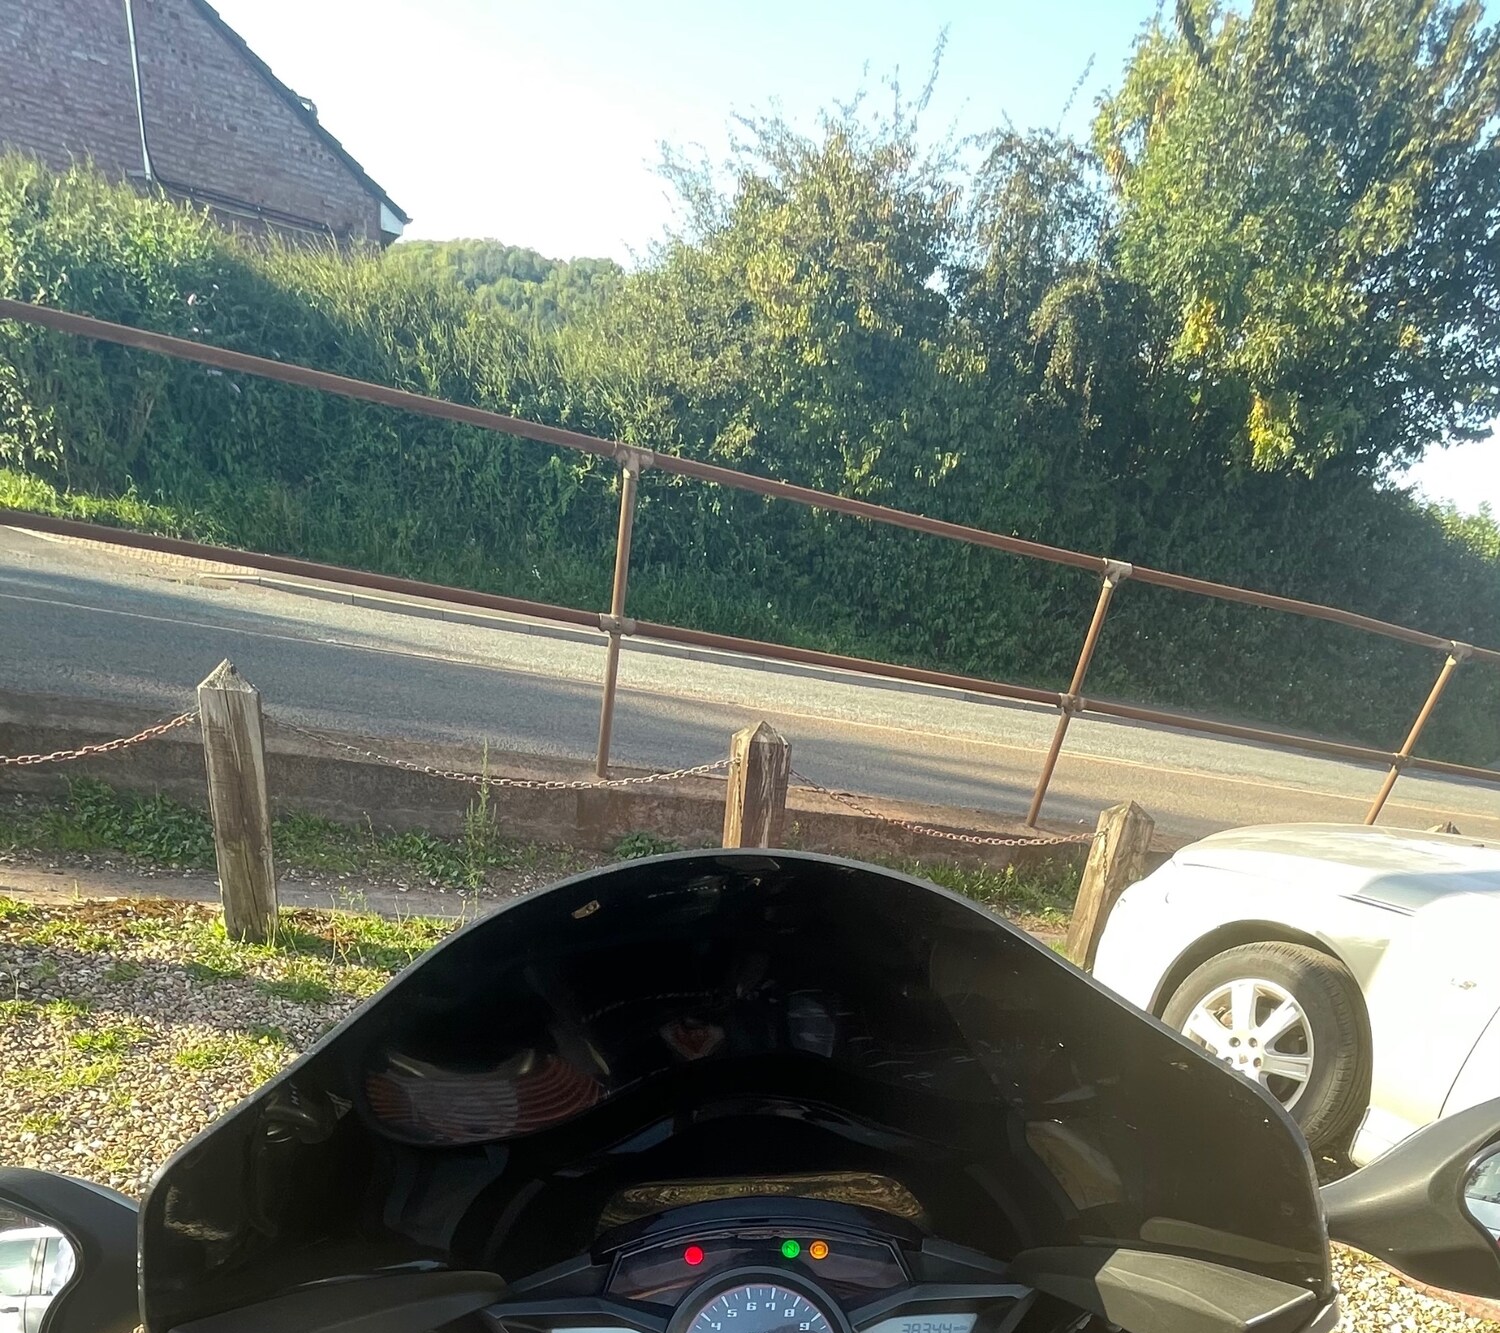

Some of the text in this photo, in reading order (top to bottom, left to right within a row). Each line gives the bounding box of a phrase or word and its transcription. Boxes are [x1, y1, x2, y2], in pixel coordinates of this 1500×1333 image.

[746, 1302, 757, 1311] 6
[765, 1302, 776, 1311] 7
[727, 1308, 738, 1318] 5
[784, 1308, 795, 1318] 8
[710, 1322, 721, 1331] 4
[799, 1322, 810, 1331] 9
